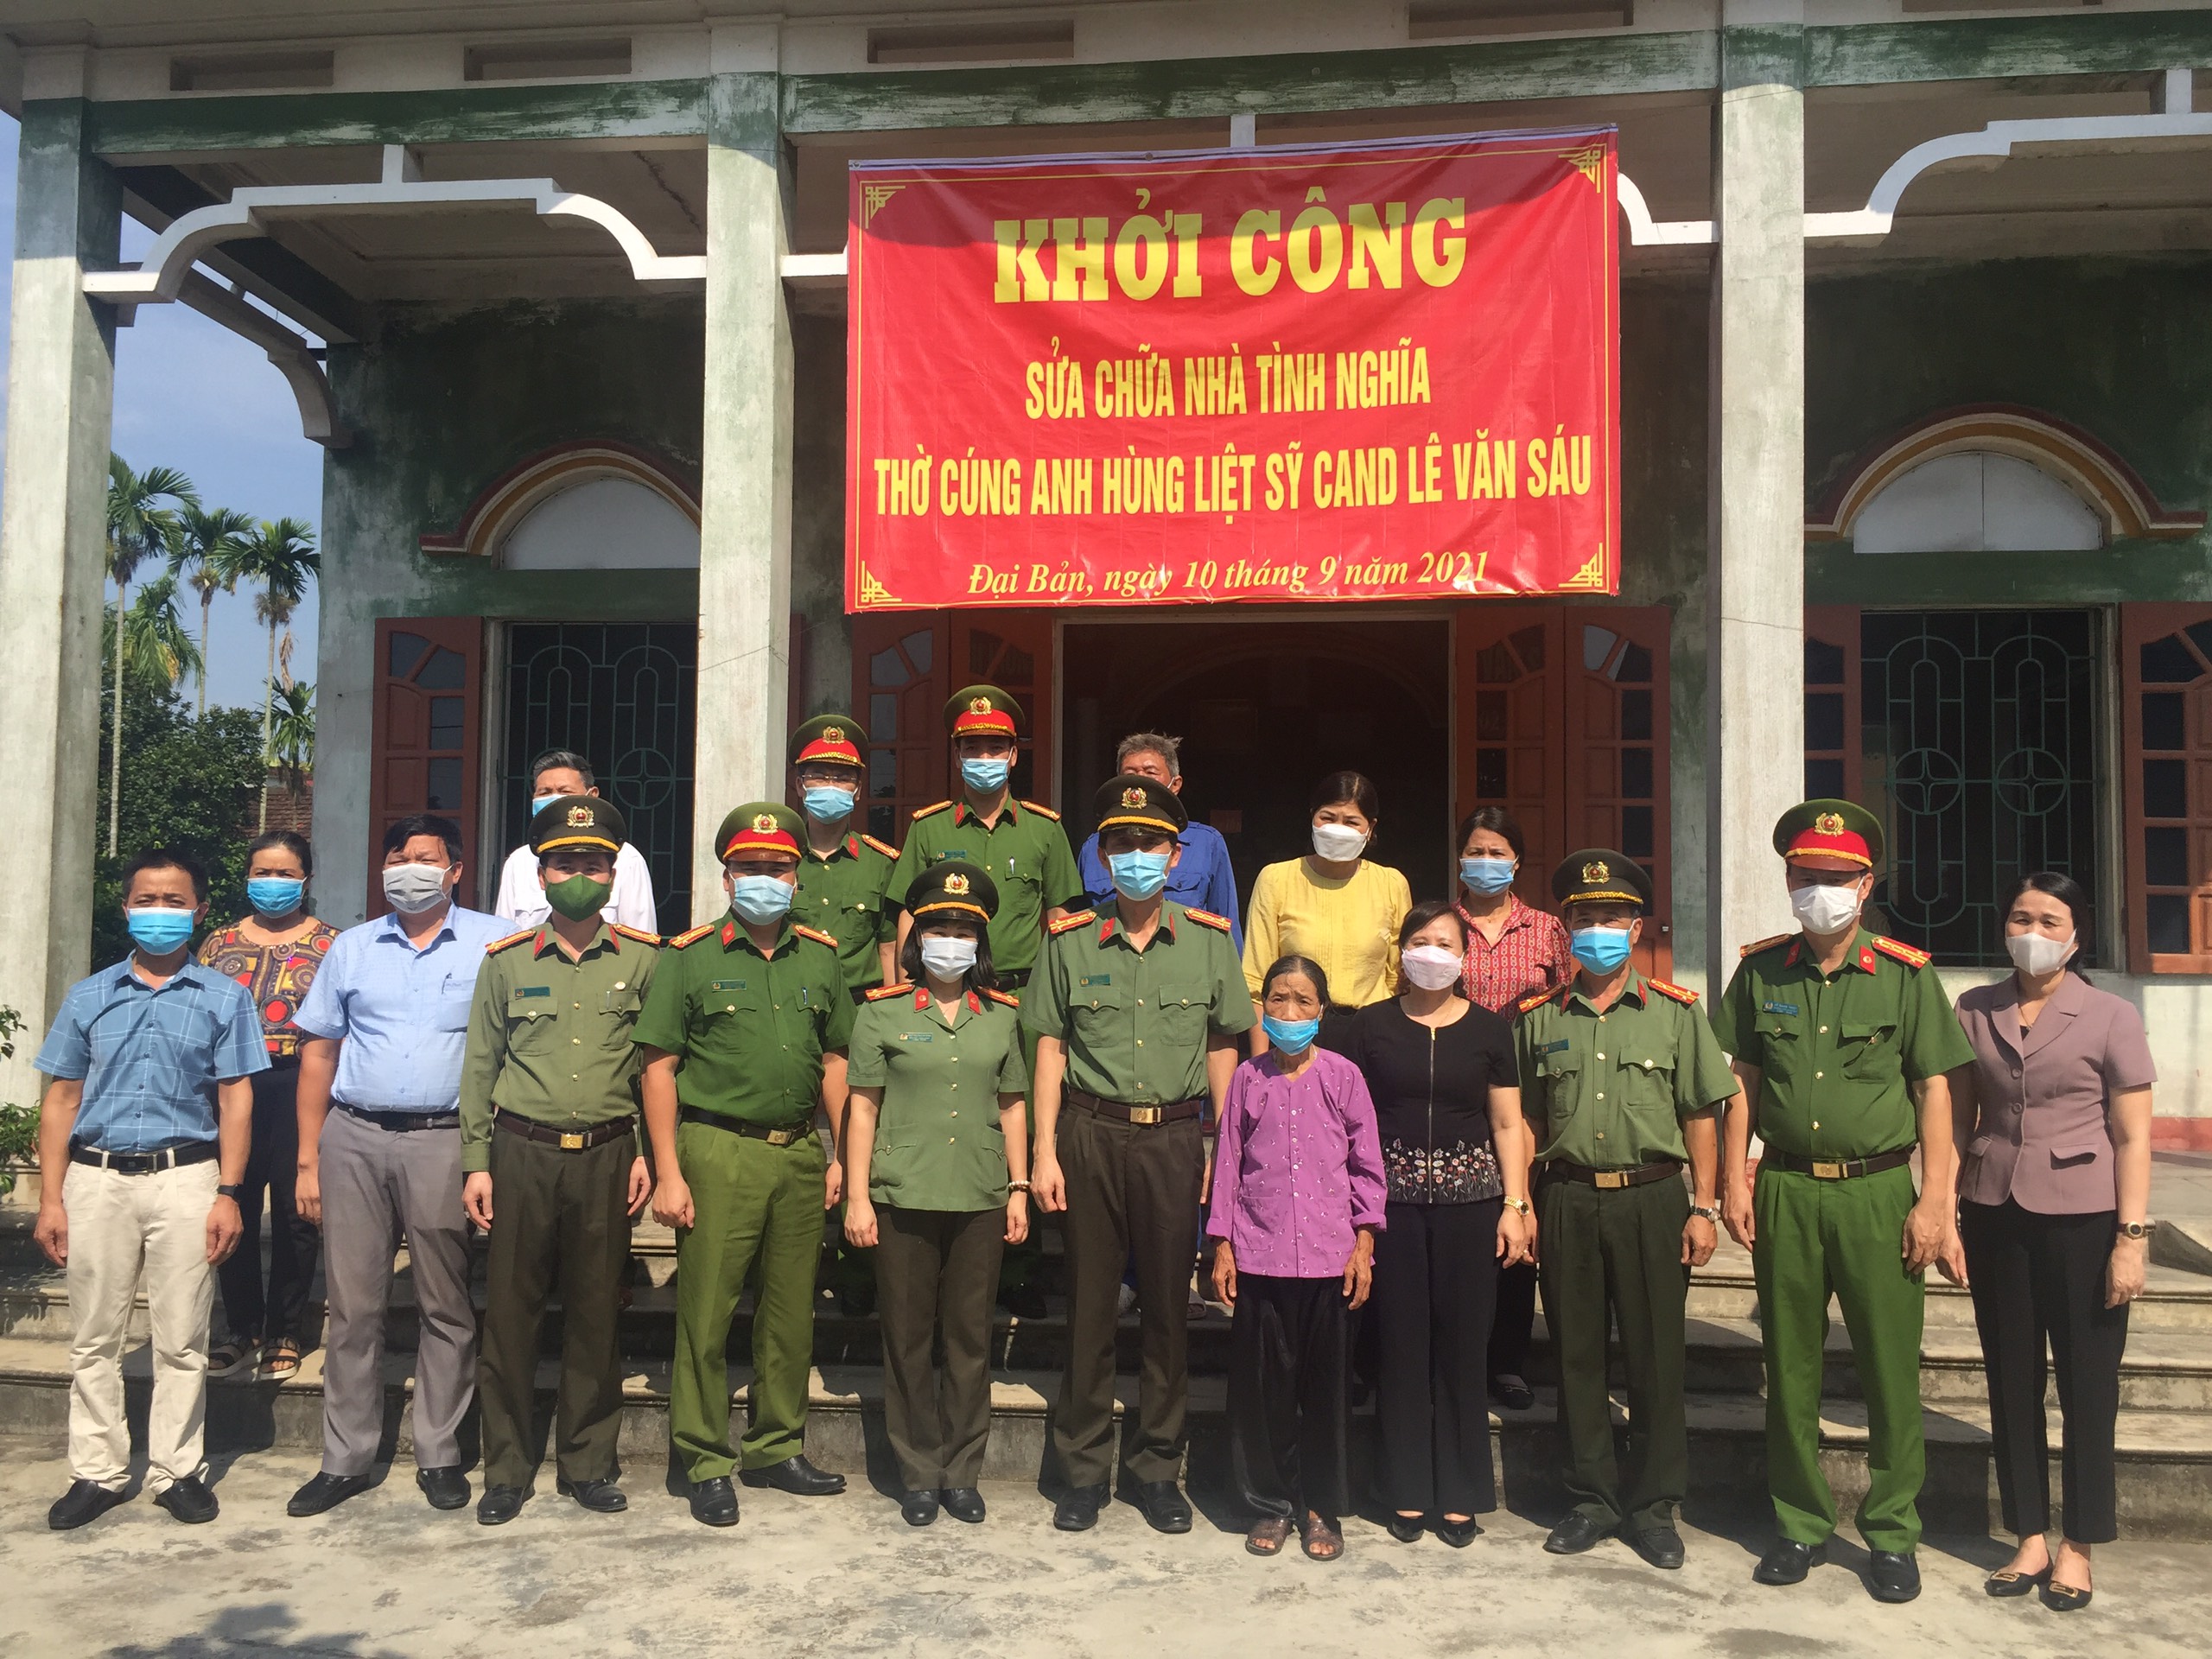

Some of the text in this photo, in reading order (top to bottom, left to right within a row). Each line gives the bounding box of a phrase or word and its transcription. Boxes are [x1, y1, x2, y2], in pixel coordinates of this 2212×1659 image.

[995, 186, 1466, 302] KHỞI CÔNG
[1026, 336, 1431, 419] SỬA CHỮA NHÀ TÌNH NGHĨA
[874, 423, 1591, 524] THỜ CÚNG ANH HÙNG LIỆT SỸ CAND LÊ VĂN SÁU
[968, 550, 1488, 599] Đại Bản, ngày 10 tháng 9 năm 2021
